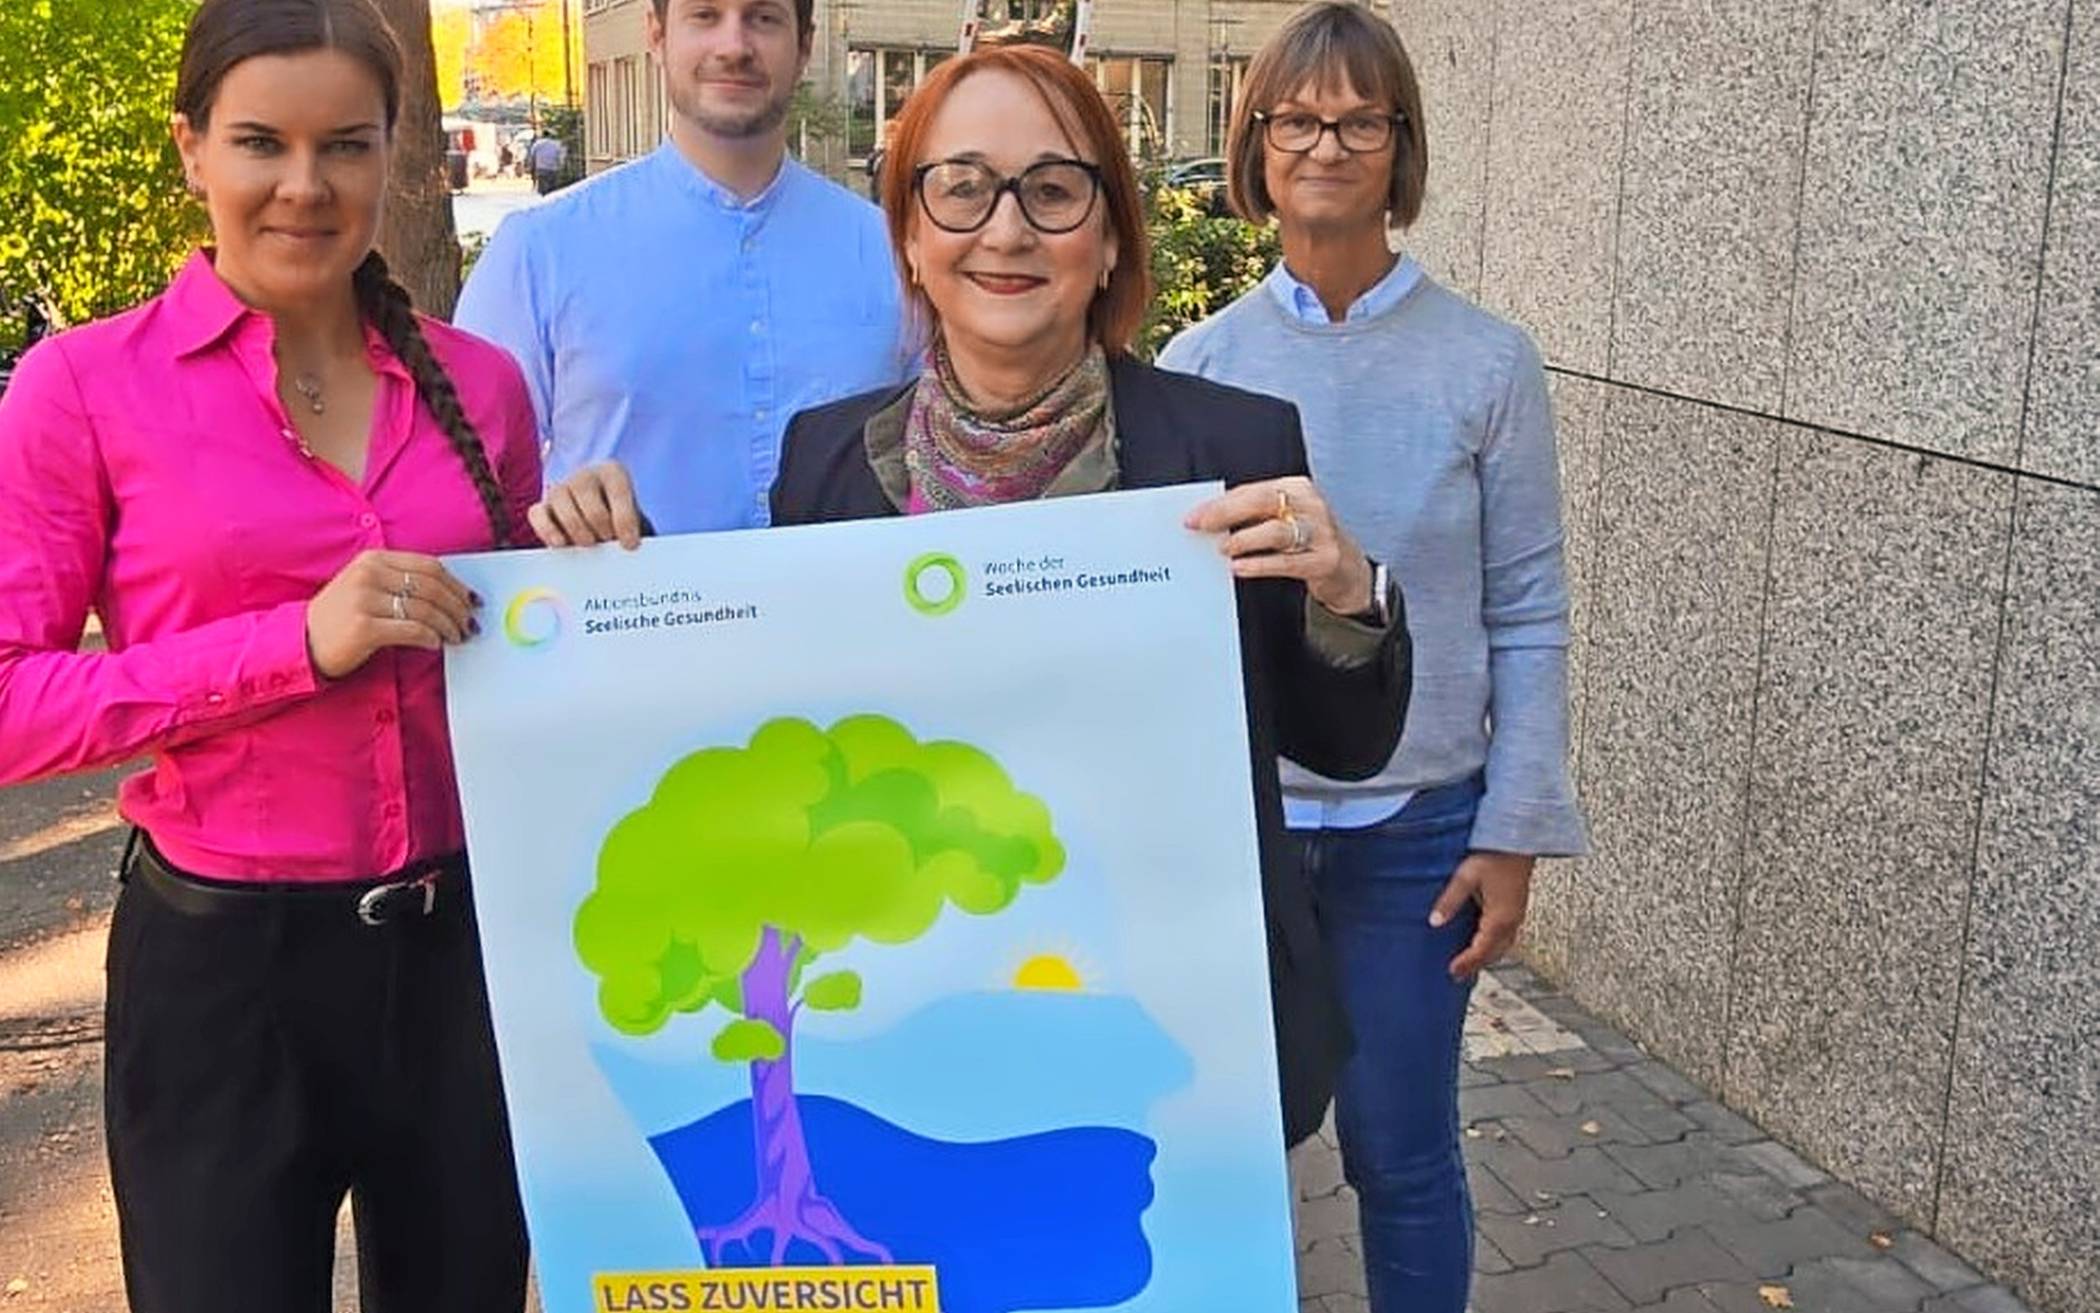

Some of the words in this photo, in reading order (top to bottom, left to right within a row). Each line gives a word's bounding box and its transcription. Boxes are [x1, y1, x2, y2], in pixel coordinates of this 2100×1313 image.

[985, 557, 1036, 575] Woche
[1039, 556, 1065, 571] der
[985, 576, 1073, 597] Seelischen
[1077, 566, 1171, 589] Gesundheit
[585, 613, 660, 635] Seelische
[664, 604, 758, 627] Gesundheit
[603, 1283, 692, 1312] LASS
[700, 1279, 928, 1310] ZUVERSICHT
